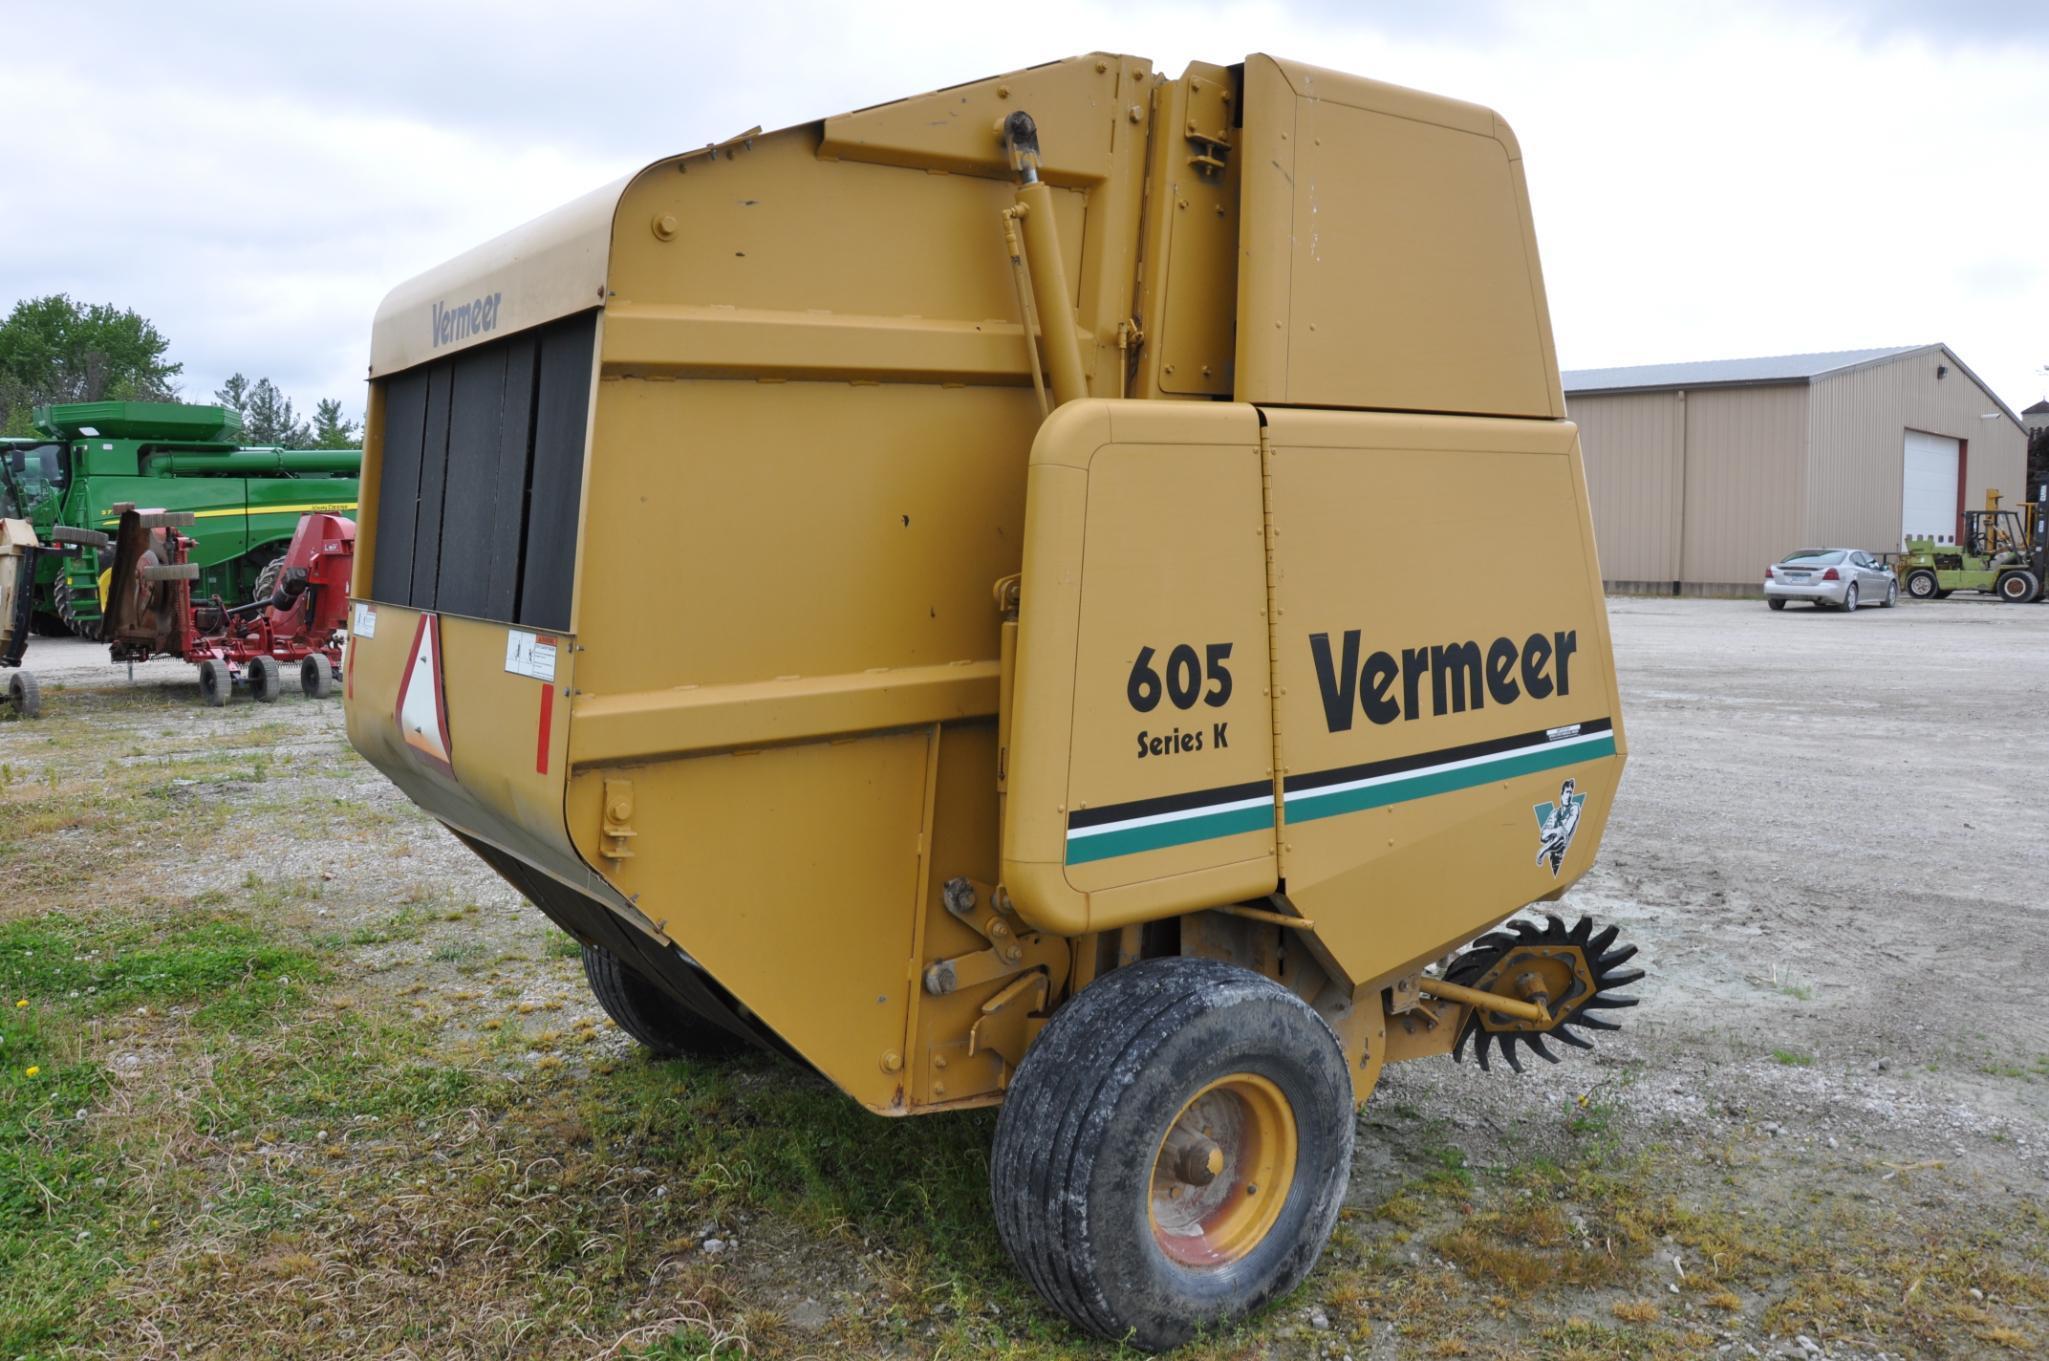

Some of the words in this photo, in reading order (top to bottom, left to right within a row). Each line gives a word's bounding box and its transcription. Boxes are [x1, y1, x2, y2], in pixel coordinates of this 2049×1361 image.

[432, 292, 502, 348] Vermeer
[1127, 643, 1233, 712] 605
[1309, 629, 1577, 733] Vermeer
[1137, 730, 1203, 758] Series
[1213, 723, 1228, 748] K
